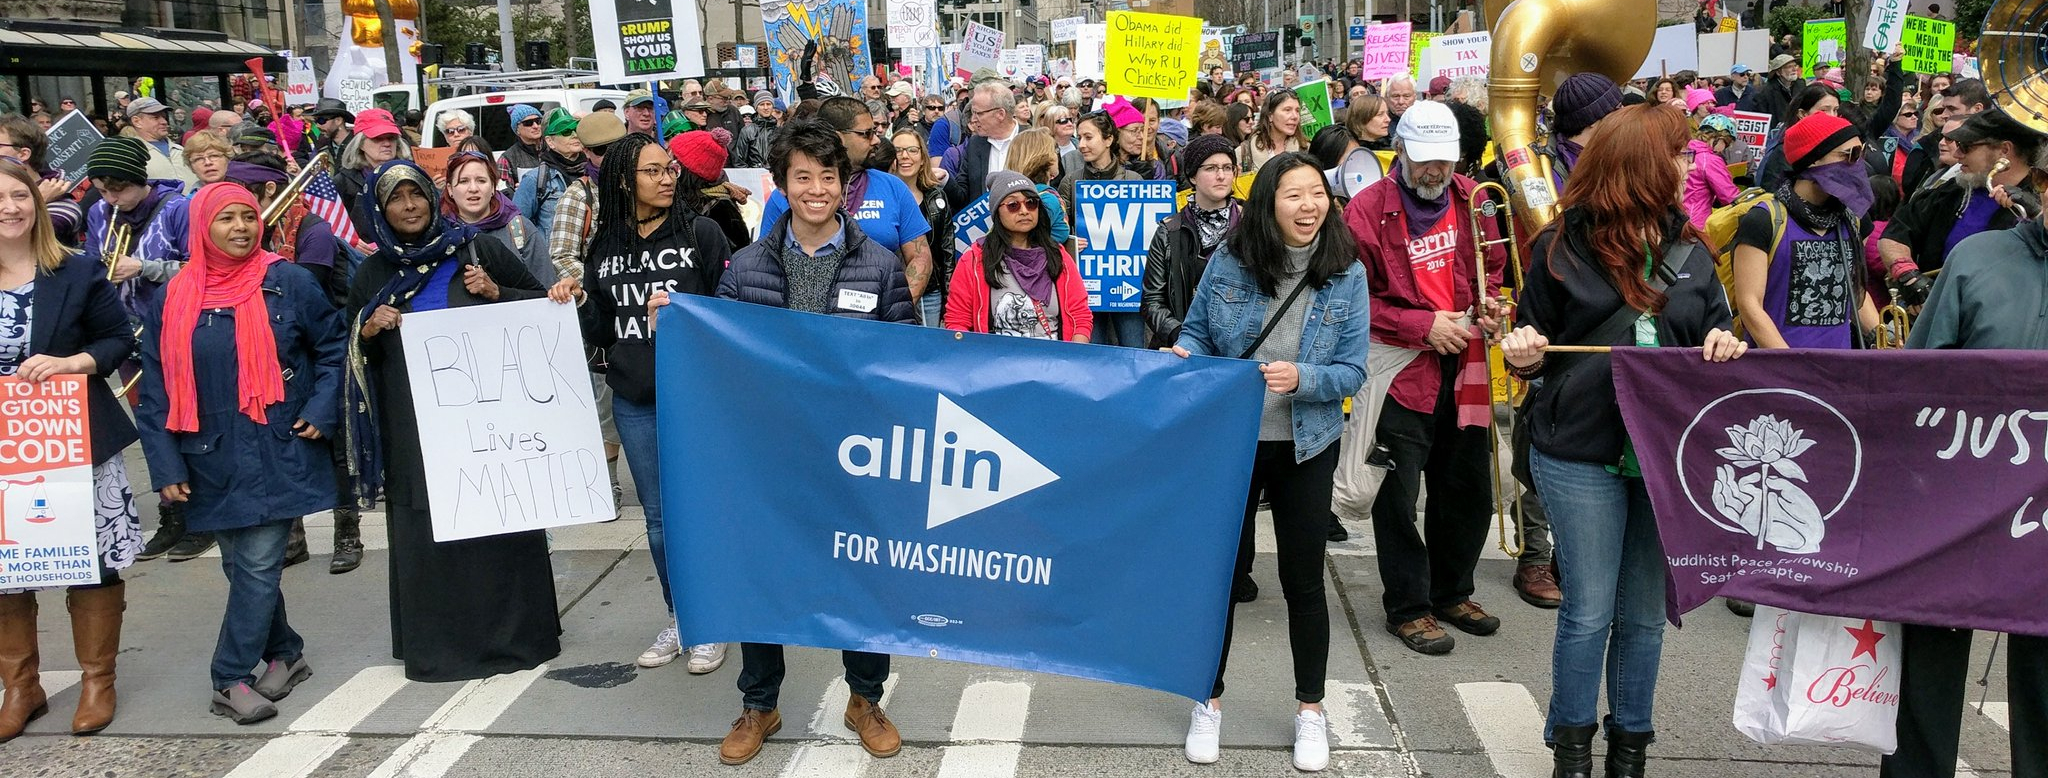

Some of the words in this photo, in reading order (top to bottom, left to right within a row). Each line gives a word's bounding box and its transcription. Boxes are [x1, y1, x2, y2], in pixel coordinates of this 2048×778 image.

[1878, 6, 1898, 23] THE
[976, 24, 998, 35] SHOW
[1905, 18, 1926, 31] WE'RE
[1931, 22, 1946, 35] NOT
[624, 35, 654, 45] SHOW
[659, 33, 671, 42] US
[974, 32, 996, 47] US
[1366, 33, 1407, 45] RELEASE
[1467, 36, 1487, 44] YOUR
[1915, 33, 1938, 48] MEDIA
[625, 43, 672, 58] YOUR
[973, 42, 992, 53] YOUR
[1243, 52, 1255, 60] YOU
[1257, 50, 1274, 58] SHOW
[1903, 44, 1923, 58] SHOW
[1925, 48, 1935, 60] US
[1938, 50, 1951, 61] THE
[1128, 53, 1156, 69] Why
[1160, 55, 1169, 68] R
[1173, 57, 1181, 69] U
[1366, 51, 1407, 65] DIVEST
[1456, 50, 1478, 61] TAX
[1914, 59, 1937, 74] TAXES
[288, 83, 314, 94] NOW
[341, 80, 358, 89] SHOW
[361, 81, 371, 90] US
[50, 144, 63, 156] IS
[1080, 184, 1172, 199] TOGETHER
[598, 247, 694, 279] #BLACK
[1427, 259, 1445, 271] 2016
[424, 321, 587, 408] BLACK
[4, 382, 34, 398] TO
[41, 380, 80, 396] FLIP
[1, 398, 81, 416] GTON'S
[7, 418, 83, 436] DOWN
[466, 418, 547, 453] Lives
[0, 439, 84, 464] CODE
[454, 447, 611, 530] MATTER
[25, 545, 90, 558] FAMILIES
[833, 531, 879, 564] FOR
[888, 540, 1052, 585] WASHINGTON
[8, 560, 49, 573] MORE
[54, 559, 91, 570] THAN
[1731, 554, 1773, 567] Peace
[1776, 557, 1859, 578] Fellowship
[16, 571, 92, 583] HOUSEHOLDS
[1806, 664, 1899, 708] Believe
